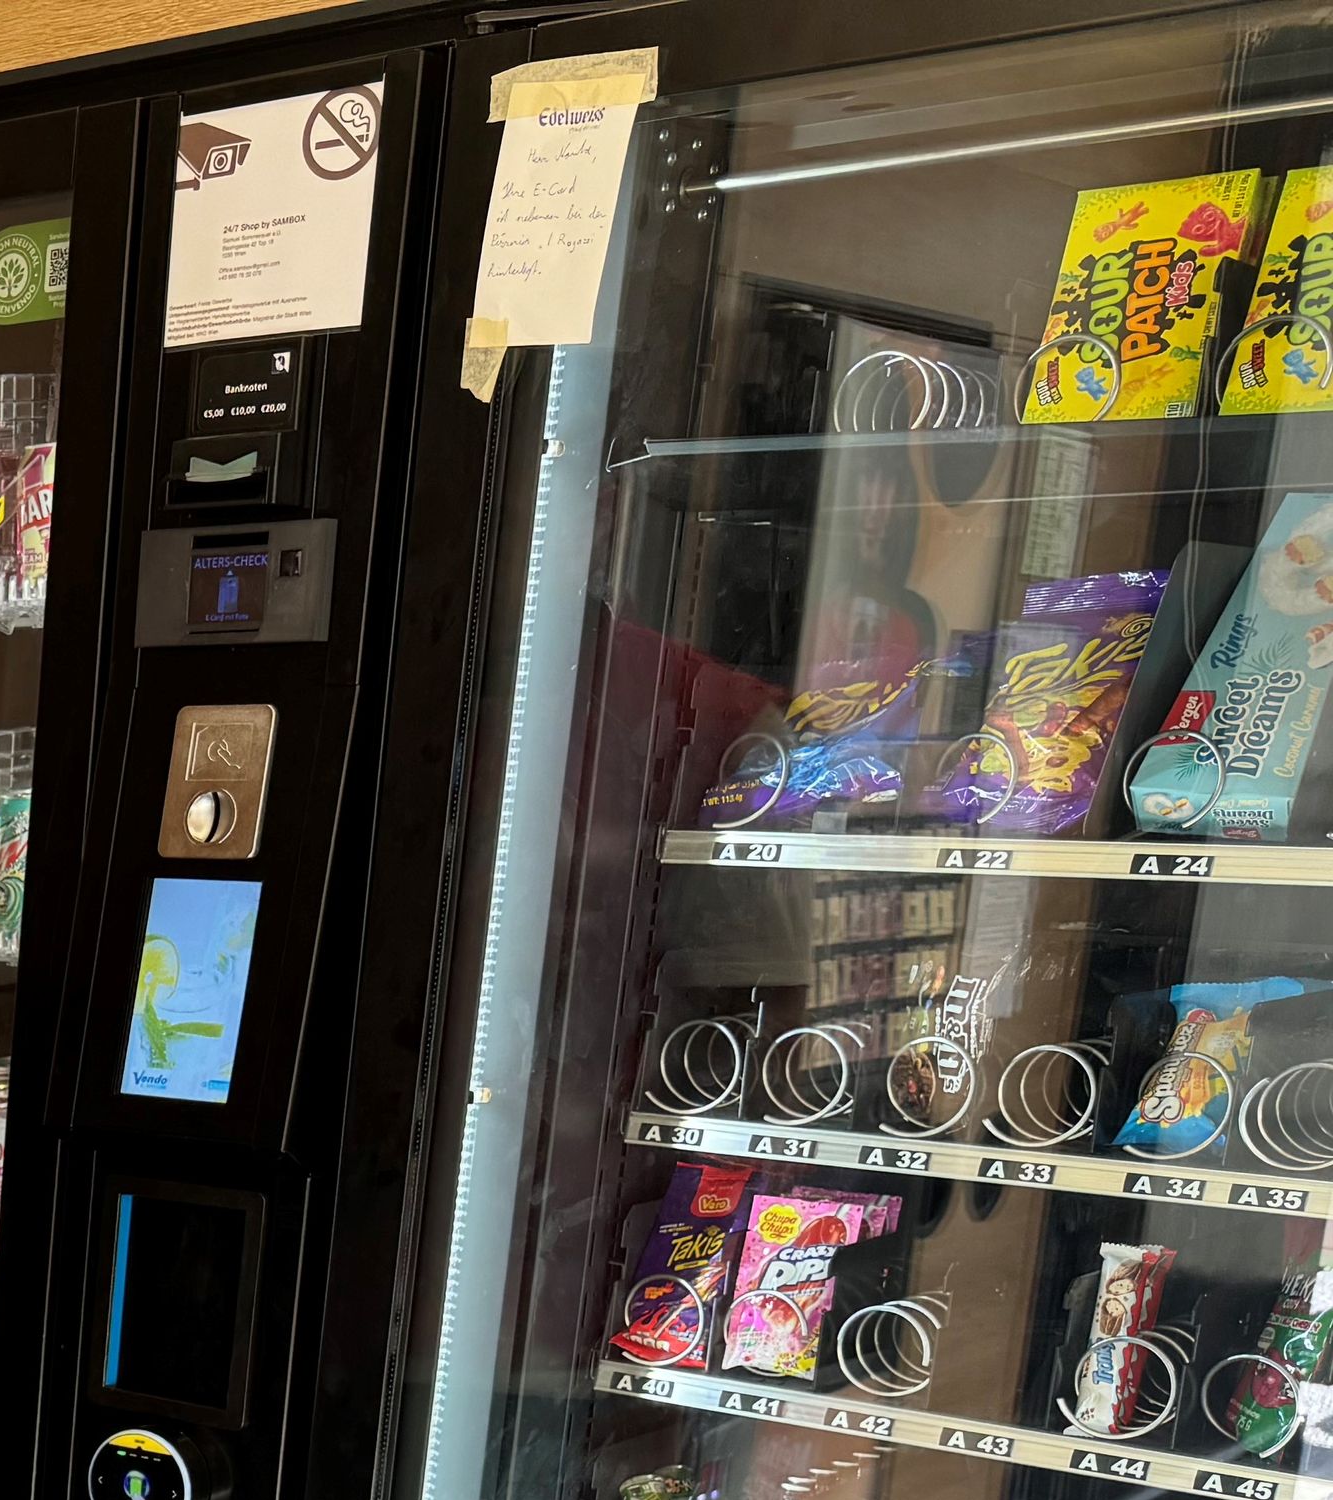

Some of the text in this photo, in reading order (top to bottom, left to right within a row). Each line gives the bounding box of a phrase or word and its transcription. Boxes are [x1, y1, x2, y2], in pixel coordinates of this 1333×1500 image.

[538, 106, 606, 126] Edelweiss
[241, 222, 260, 231] Shop
[261, 220, 270, 230] by
[271, 214, 306, 227] SAMBOX
[12, 236, 40, 268] NEUTRAL
[1165, 260, 1195, 308] Kids
[1080, 252, 1134, 363] SOUR
[1120, 239, 1175, 361] PATCH
[1239, 362, 1256, 389] SOUR
[224, 382, 268, 394] Banknoten
[1035, 377, 1052, 406] SOUR
[203, 408, 224, 419] €5,00
[261, 402, 287, 413] €20,00
[193, 553, 269, 569] ALTERS-CHECK
[1211, 613, 1259, 670] Rings
[1194, 675, 1264, 766] Sweet
[1226, 669, 1306, 780] Dreams
[1274, 730, 1305, 778] Coconut
[719, 844, 777, 860] A 20
[944, 851, 1008, 868] A 22
[1138, 856, 1209, 875] A 24
[133, 1069, 169, 1086] Vendo
[644, 1126, 699, 1145] A 30
[754, 1138, 812, 1157] A 31
[866, 1149, 928, 1170] A 32
[986, 1161, 1051, 1183] A 33
[1132, 1176, 1201, 1198] A 34
[1238, 1187, 1303, 1210] A 35
[759, 1222, 795, 1239] Chups
[764, 1212, 798, 1228] Chupa
[667, 1231, 725, 1267] Takis
[779, 1244, 837, 1262] CRAZY
[616, 1376, 671, 1395] A 40
[725, 1394, 781, 1416] A 41
[830, 1412, 891, 1435] A 42
[947, 1431, 1009, 1456] A 43
[1079, 1453, 1145, 1479] A 44
[1203, 1475, 1274, 1500] A 45
